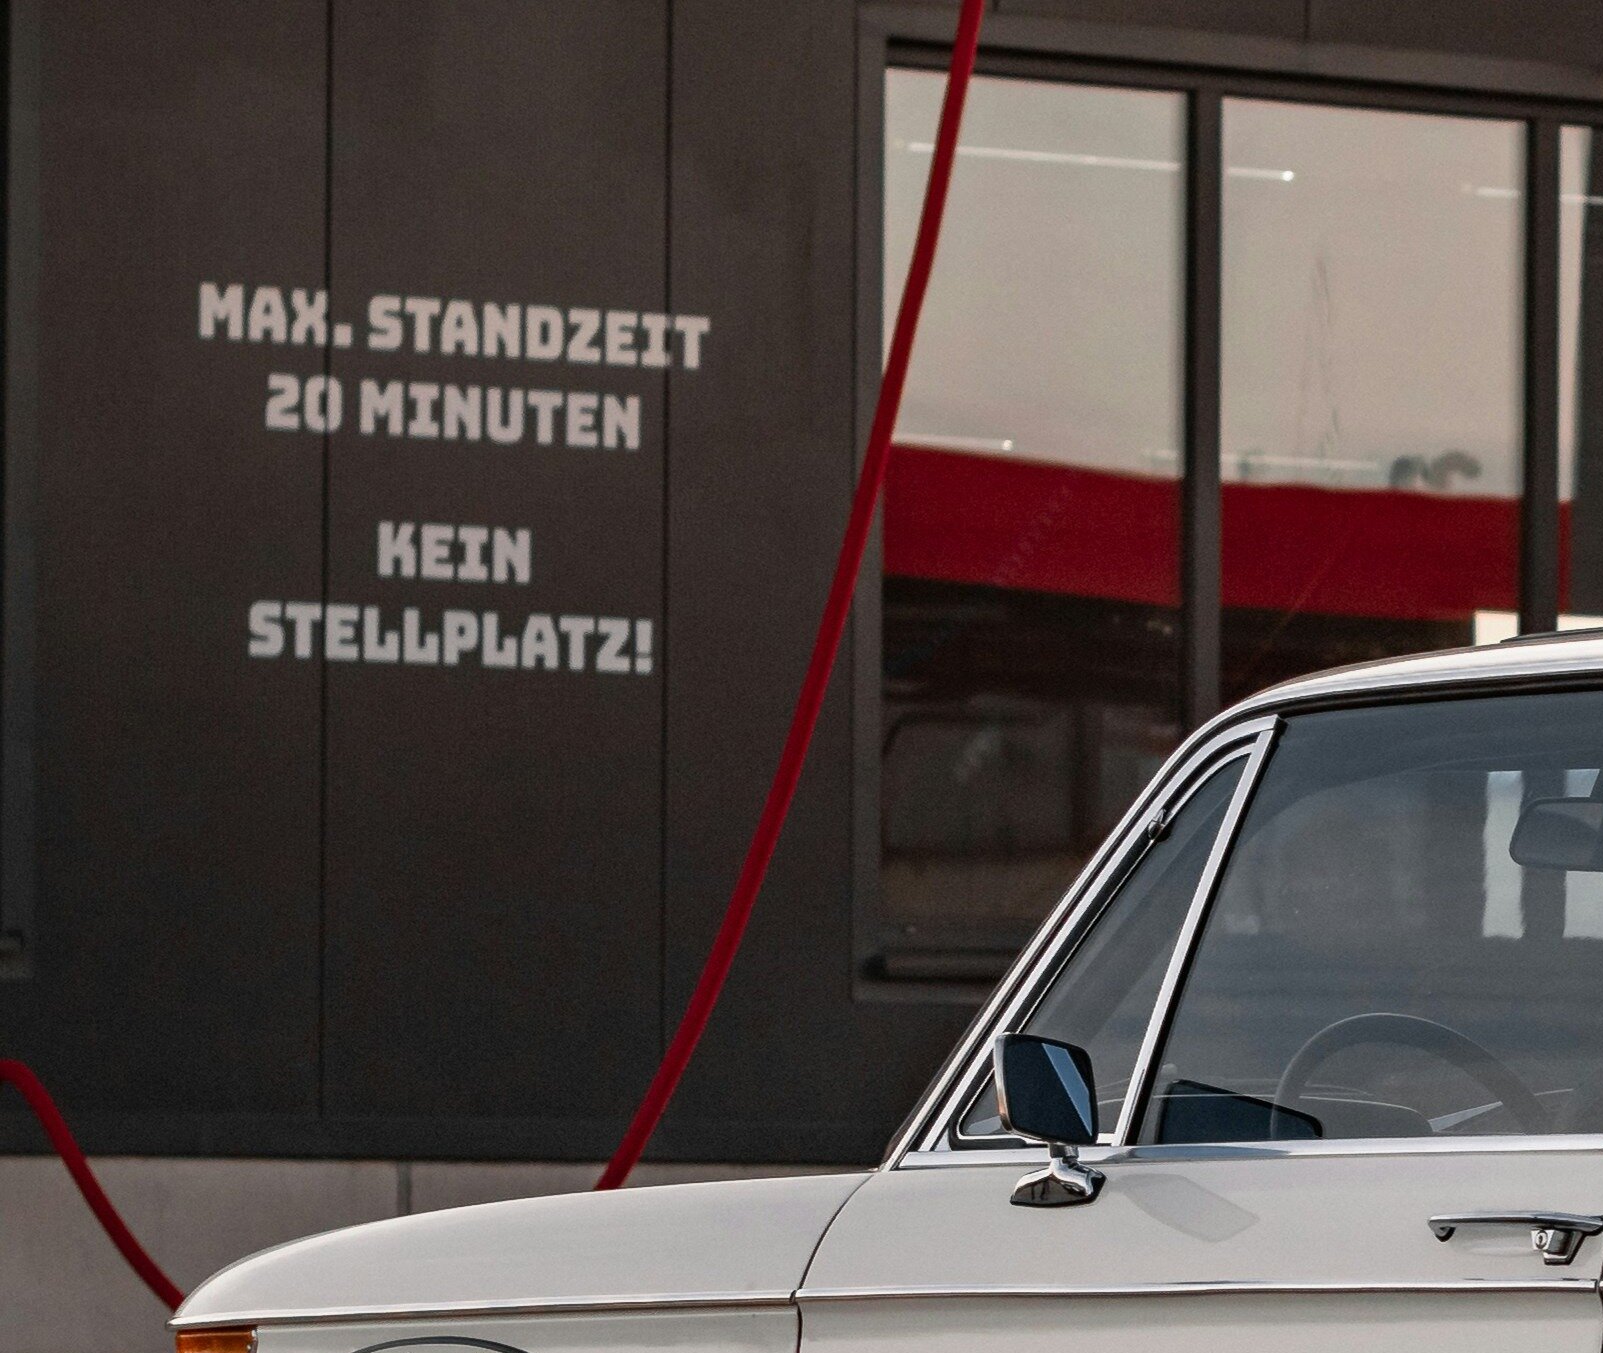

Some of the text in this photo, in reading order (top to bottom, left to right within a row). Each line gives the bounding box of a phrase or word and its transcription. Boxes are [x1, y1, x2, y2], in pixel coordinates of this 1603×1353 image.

[199, 282, 711, 371] MAX. STANDZEIT
[264, 372, 641, 451] 20 MINUTEN
[377, 520, 532, 584] KEIN
[247, 600, 654, 677] STELLPLATZ!
